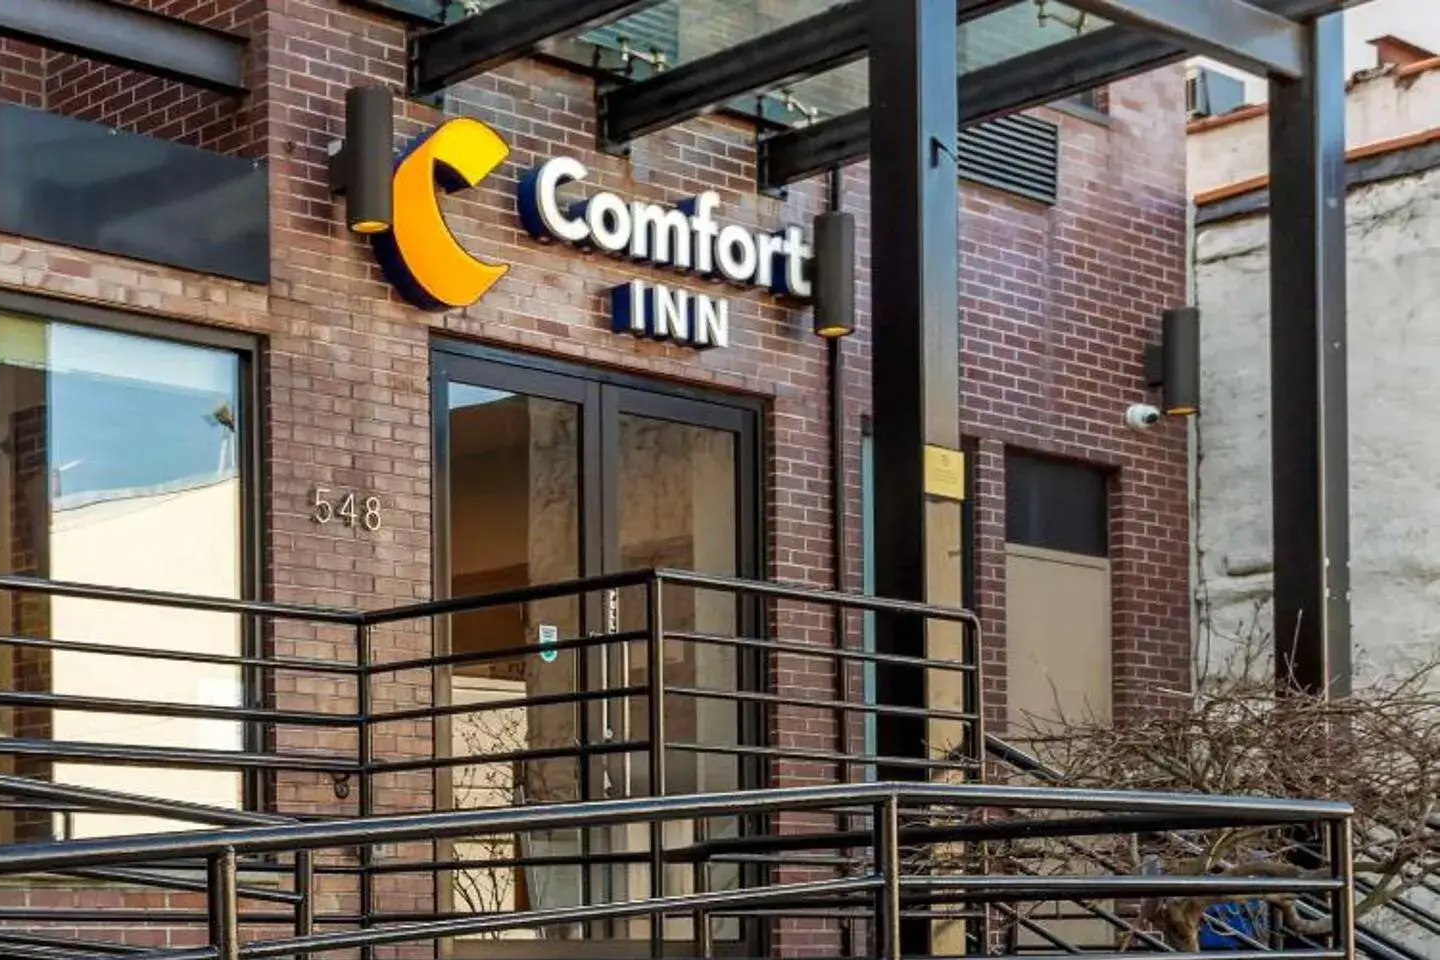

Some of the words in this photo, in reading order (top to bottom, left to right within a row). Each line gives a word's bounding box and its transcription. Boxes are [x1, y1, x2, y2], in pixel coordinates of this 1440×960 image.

[536, 156, 815, 297] Comfort
[629, 278, 729, 348] INN
[315, 488, 381, 531] 548
